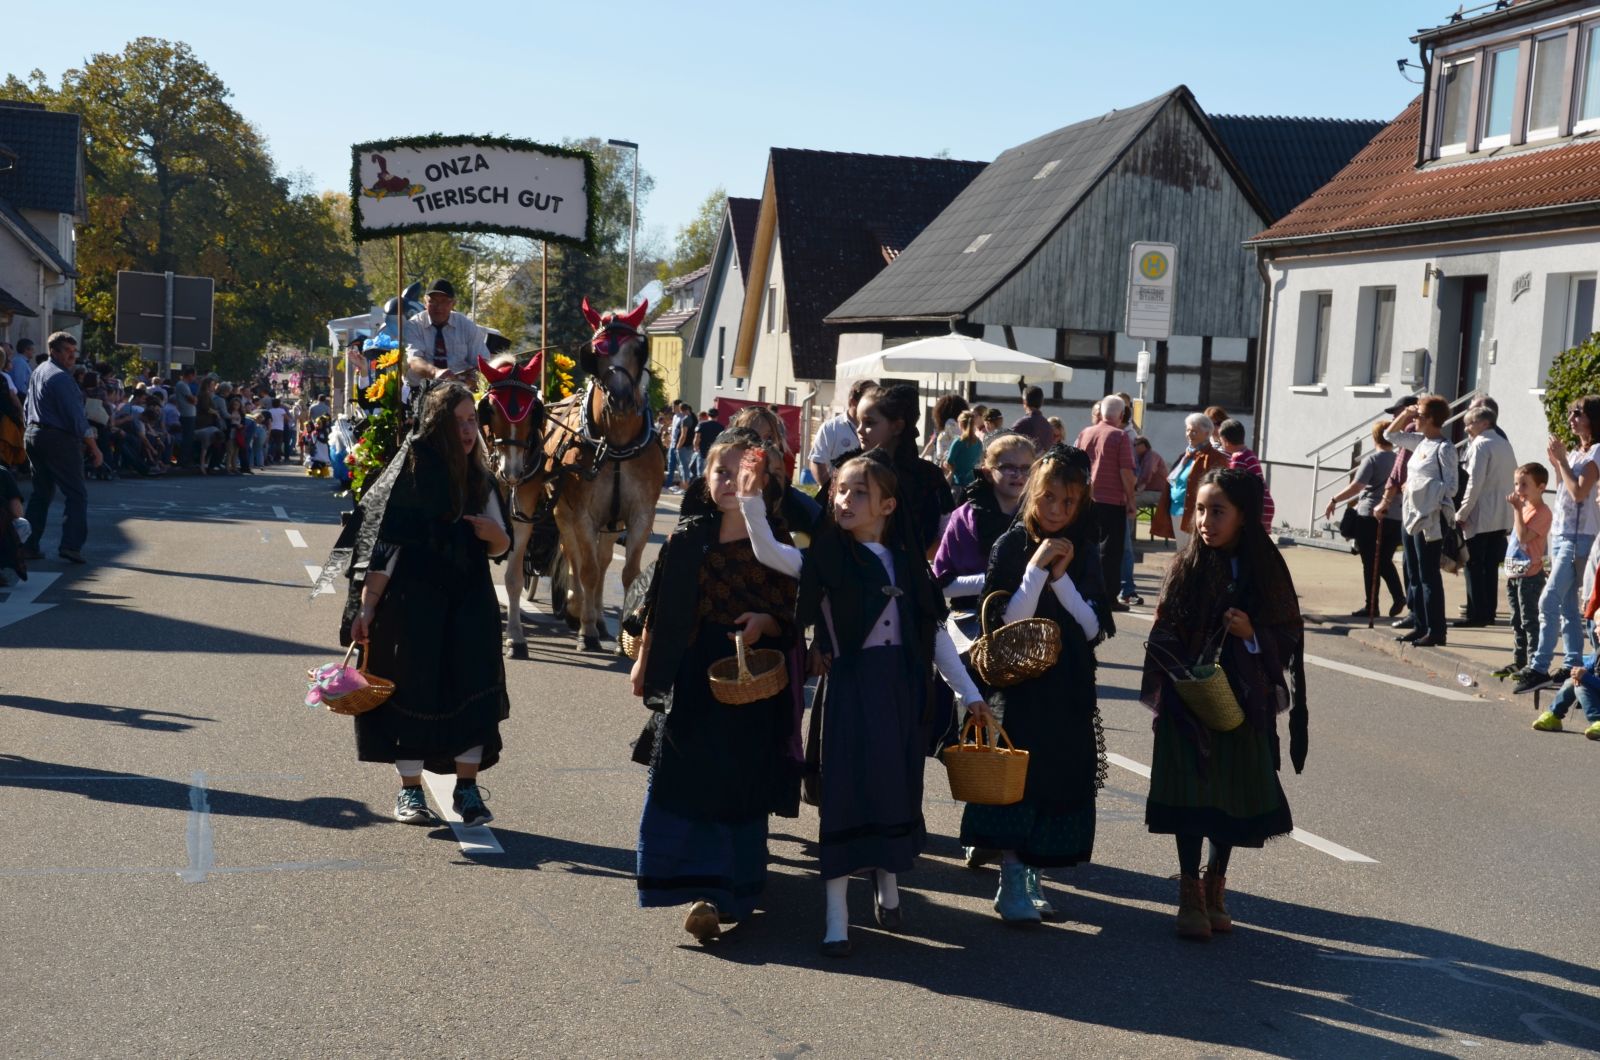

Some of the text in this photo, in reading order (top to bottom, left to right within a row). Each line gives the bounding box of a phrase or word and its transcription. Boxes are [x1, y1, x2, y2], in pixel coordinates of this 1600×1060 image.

[424, 153, 490, 183] ONZA
[412, 185, 564, 214] TIERISCH GUT
[1147, 256, 1161, 274] H
